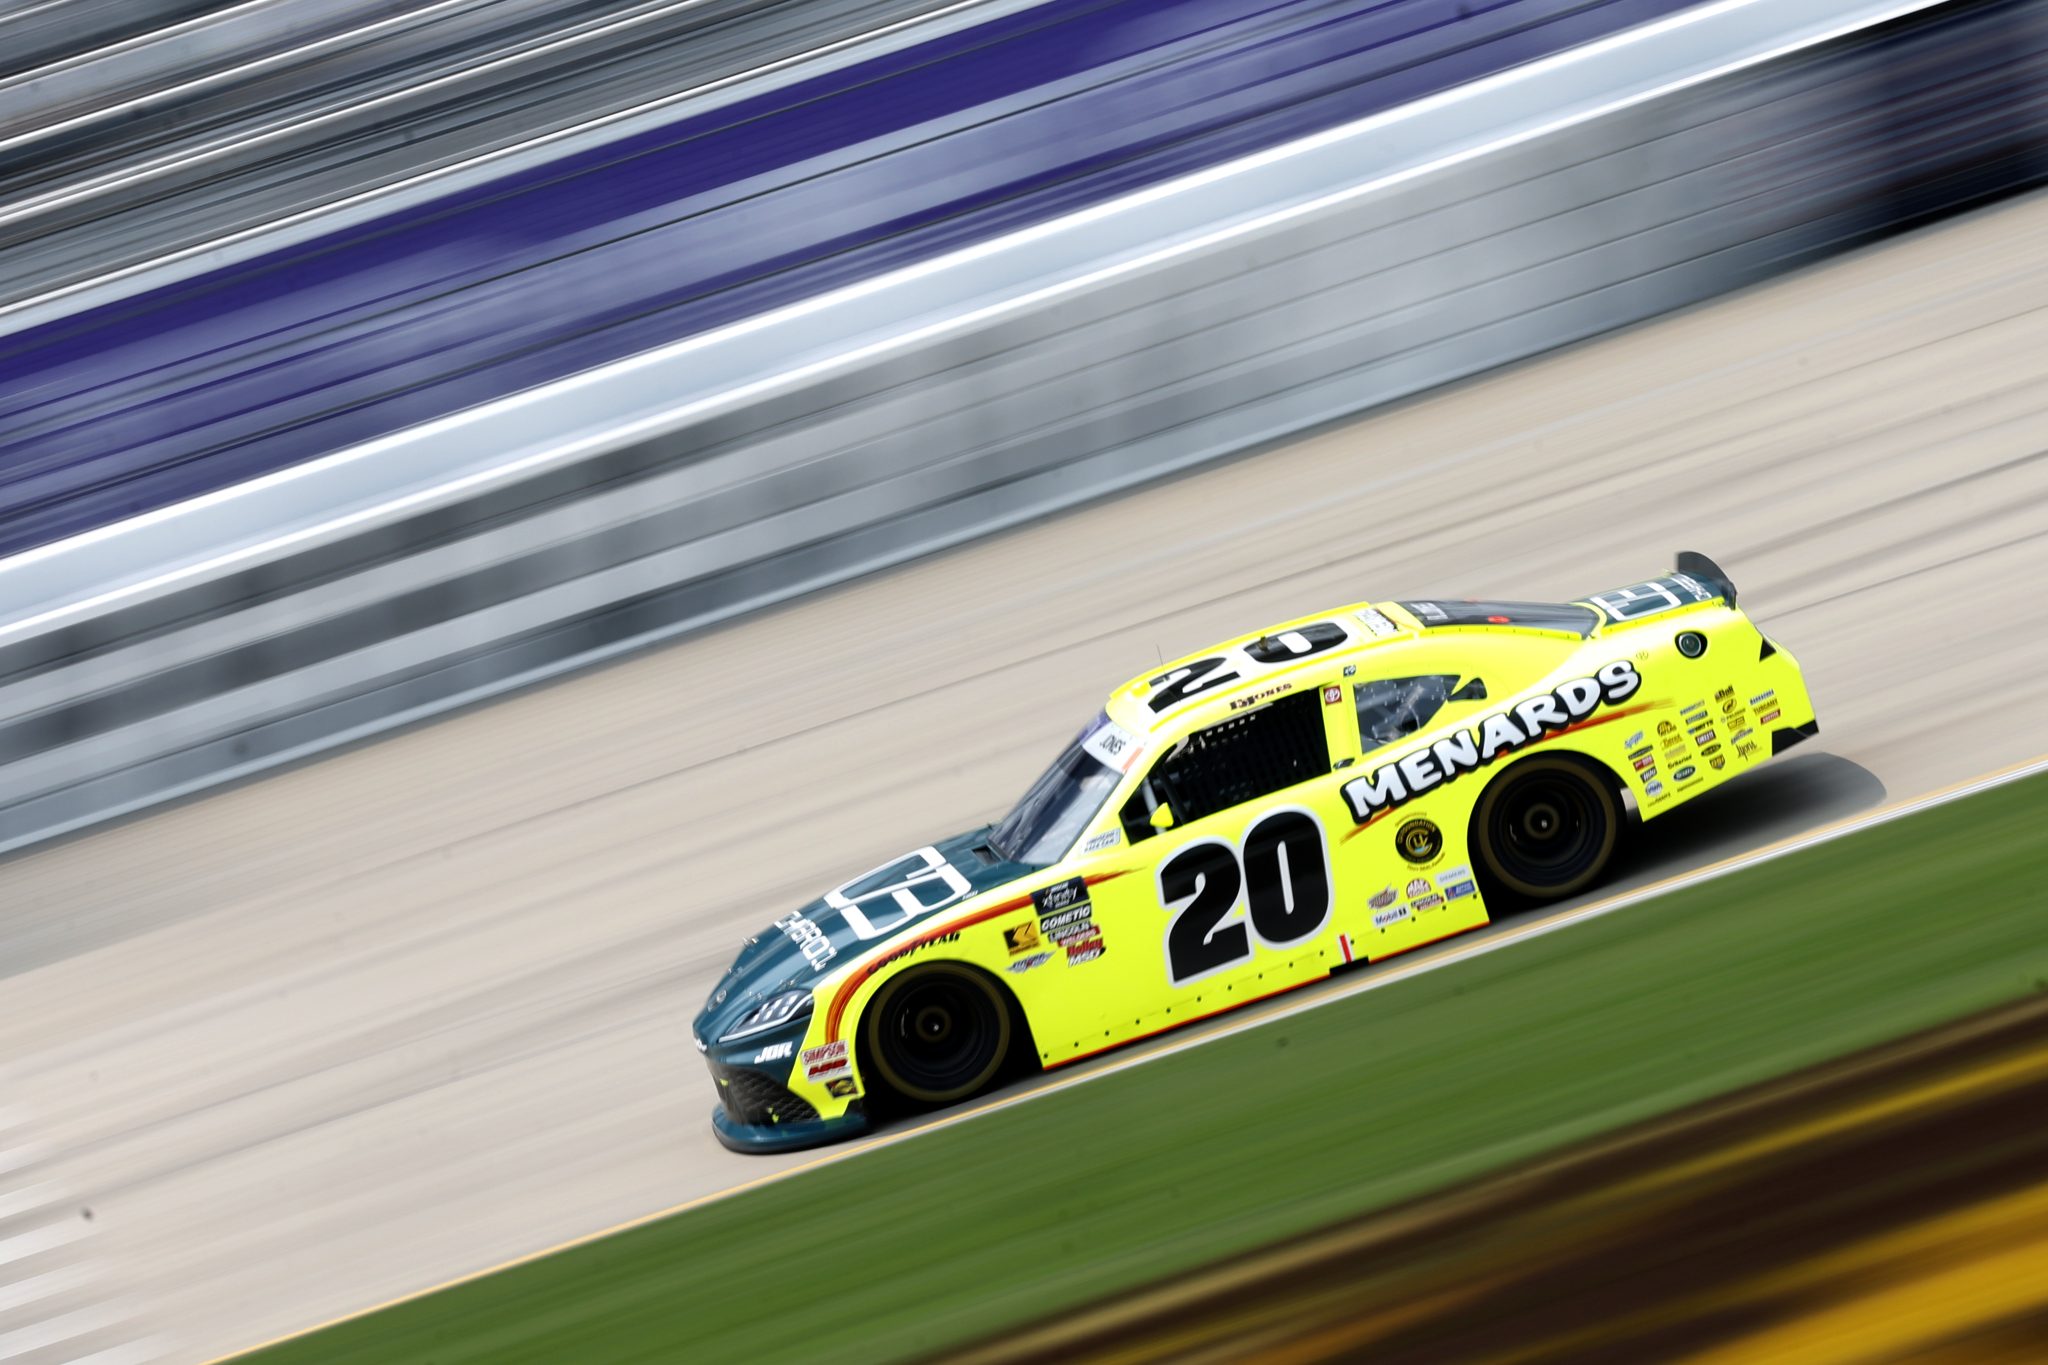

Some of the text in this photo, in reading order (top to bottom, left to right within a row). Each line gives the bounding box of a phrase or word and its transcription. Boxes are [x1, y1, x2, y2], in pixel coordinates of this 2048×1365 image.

[1148, 622, 1348, 714] 20
[1341, 660, 1641, 824] MENARDS
[1041, 905, 1091, 932] COMETIC
[1160, 811, 1329, 982] 20
